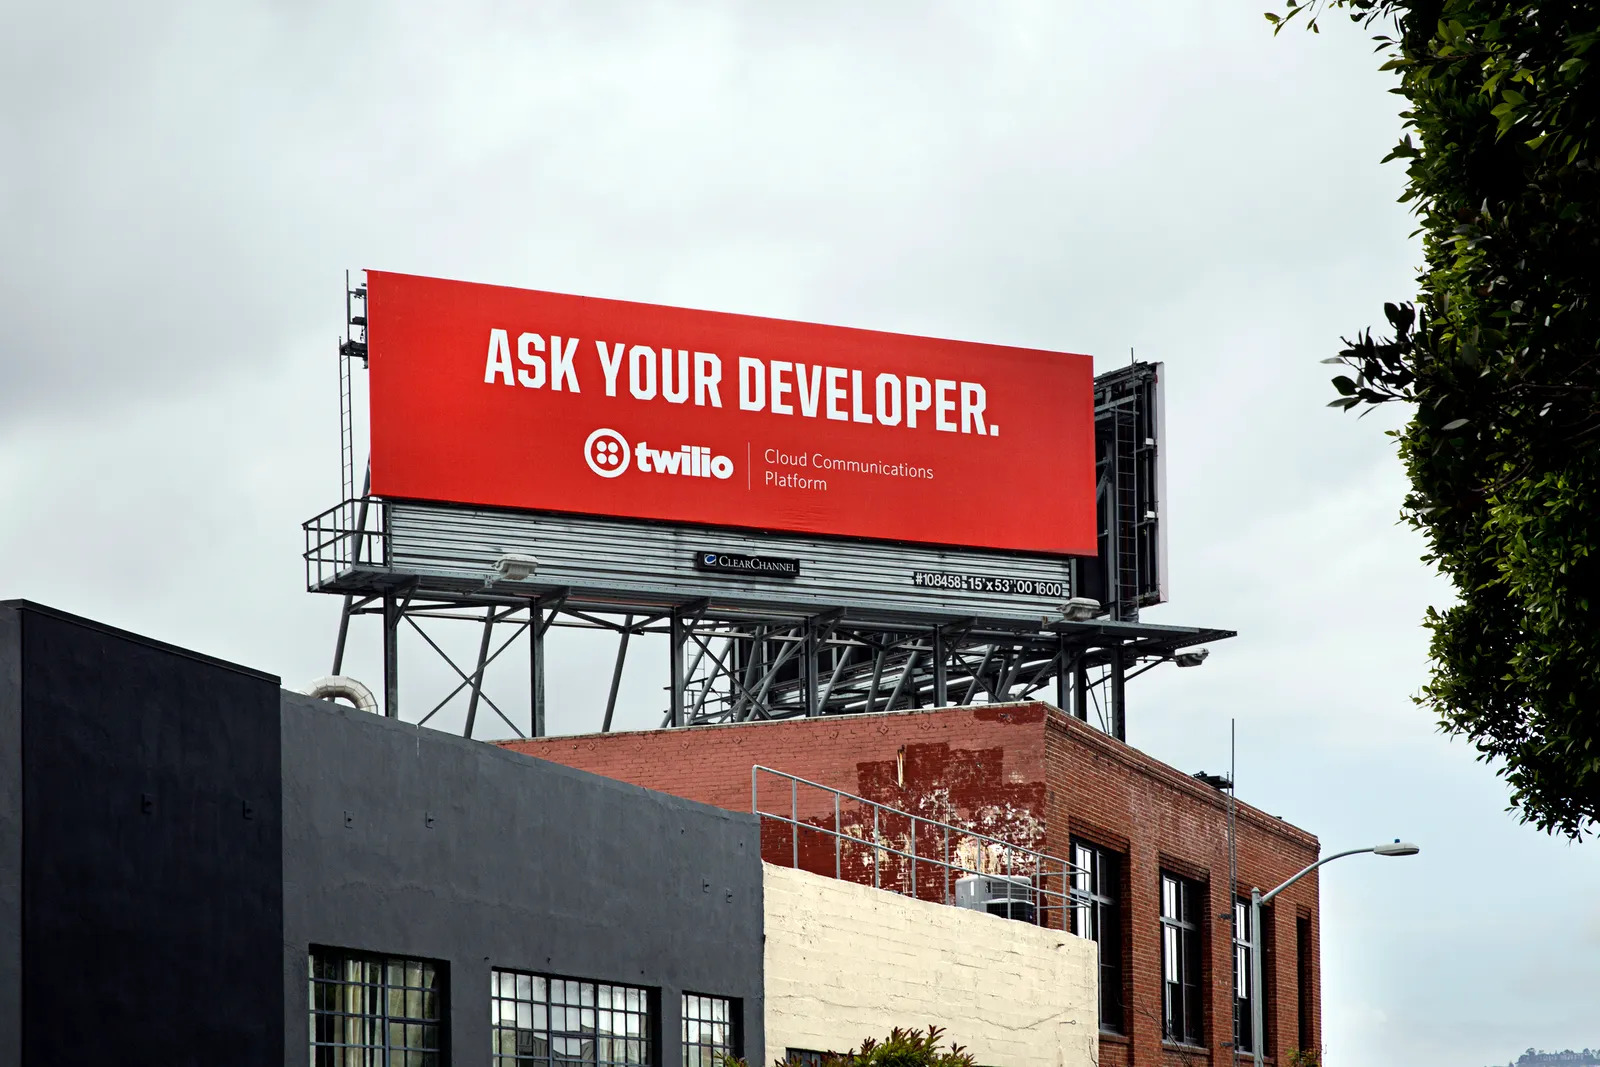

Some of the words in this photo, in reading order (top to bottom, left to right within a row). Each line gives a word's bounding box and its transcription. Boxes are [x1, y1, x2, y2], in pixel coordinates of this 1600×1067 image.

[483, 327, 581, 394] ASK
[595, 340, 723, 409] YOUR
[738, 356, 1000, 437] DEVELOPER.
[634, 441, 734, 480] twilio
[764, 448, 808, 467] Cloud
[812, 453, 934, 480] Communications
[764, 471, 827, 491] Platform
[915, 572, 961, 589] #108458
[1033, 581, 1061, 596] 1600
